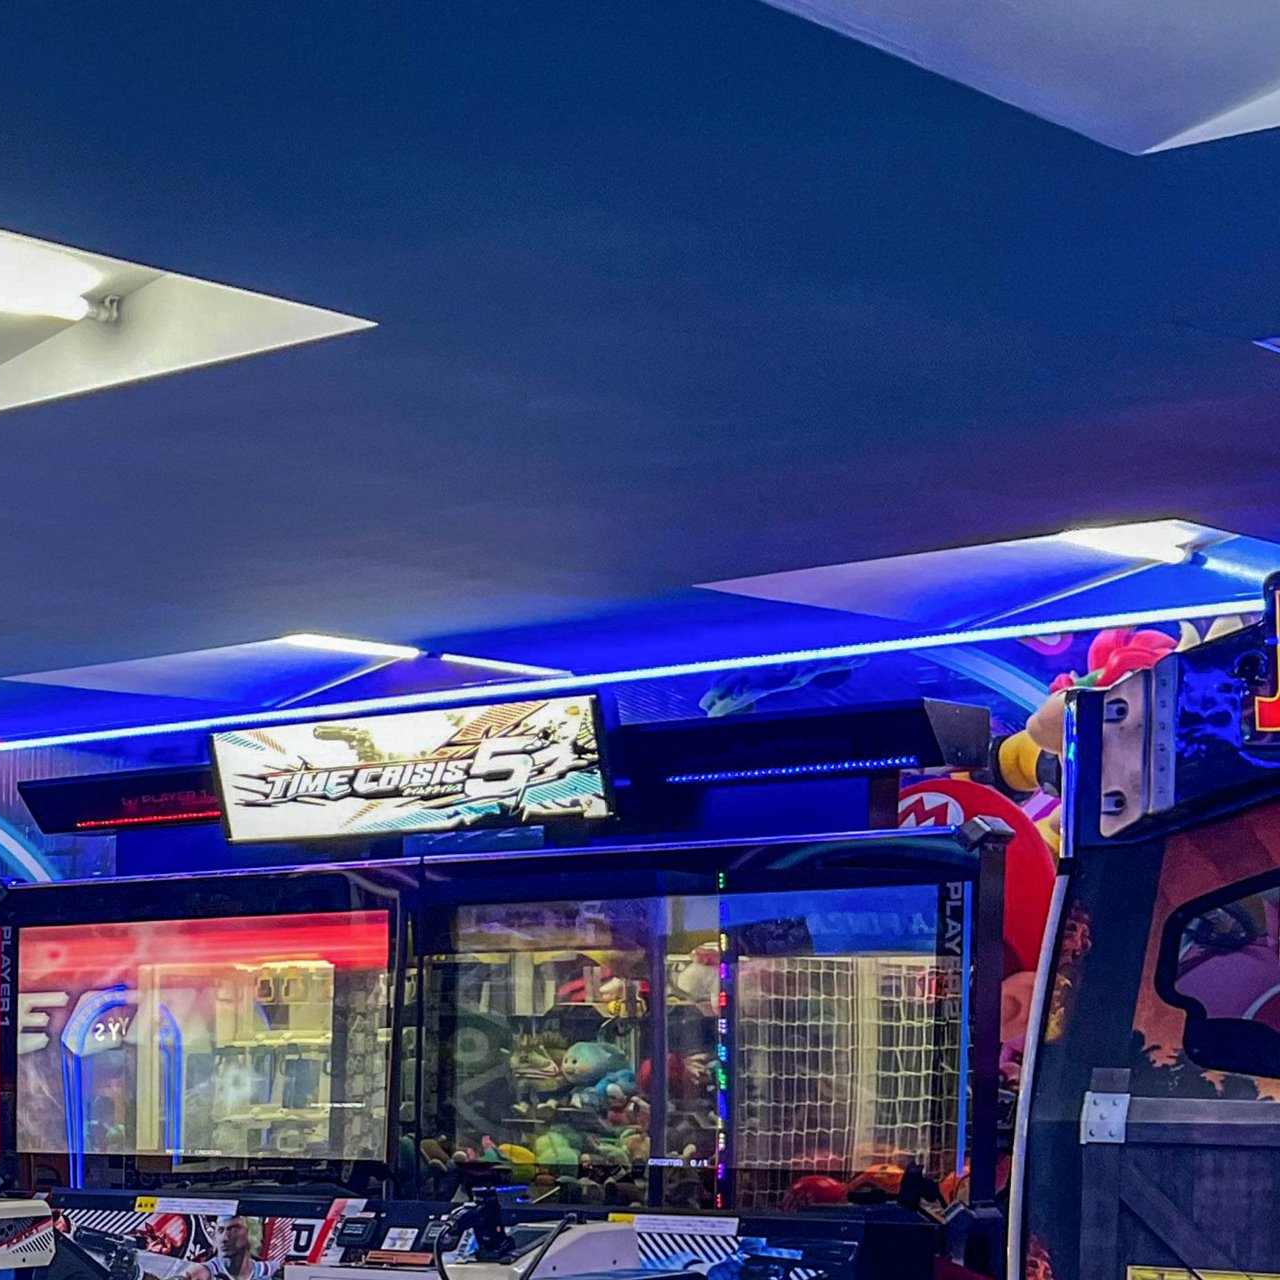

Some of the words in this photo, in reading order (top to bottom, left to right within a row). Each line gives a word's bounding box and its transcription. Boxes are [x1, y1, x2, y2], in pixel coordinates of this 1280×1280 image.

[268, 770, 350, 799] TIME
[349, 759, 473, 794] CRISIS
[465, 737, 533, 806] 5
[0, 926, 12, 1008] PLAYER
[0, 1016, 10, 1027] 1
